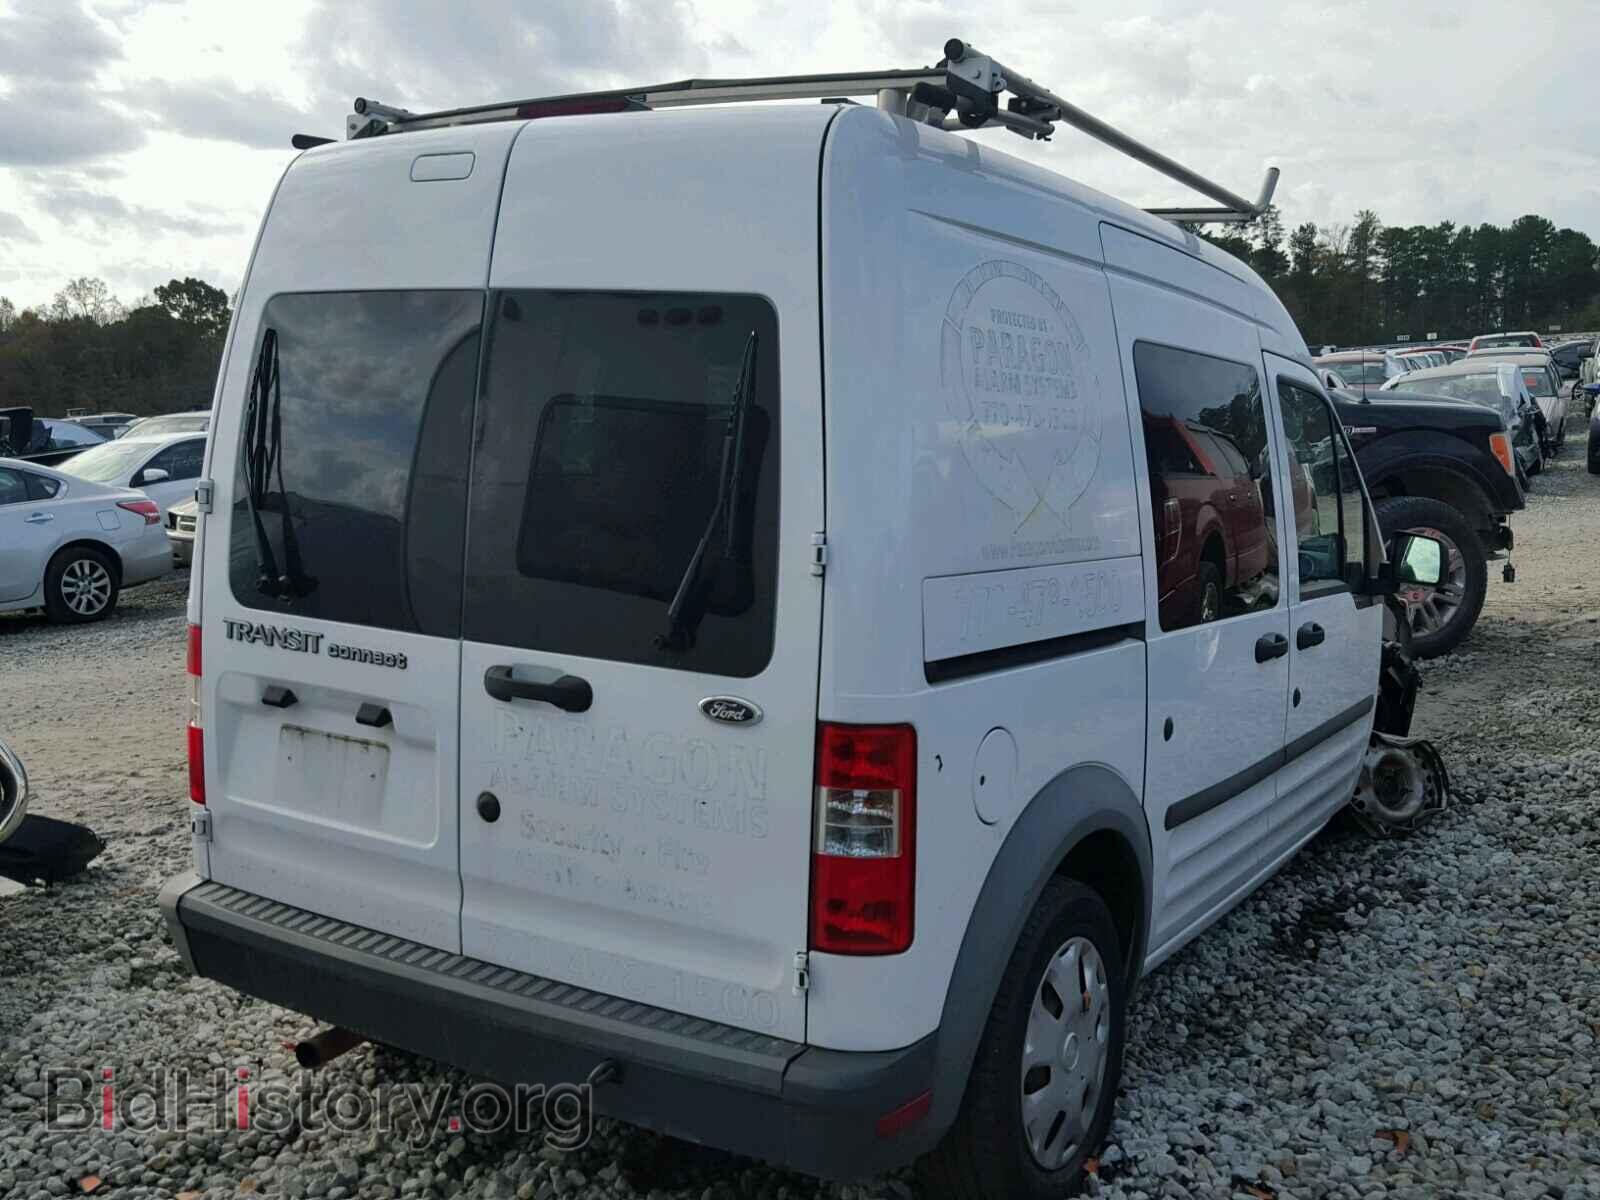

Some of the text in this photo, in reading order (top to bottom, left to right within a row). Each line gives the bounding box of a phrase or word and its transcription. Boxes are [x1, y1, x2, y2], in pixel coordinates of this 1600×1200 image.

[969, 326, 1073, 377] PARAGON
[223, 618, 408, 670] TRANSIT connect
[710, 703, 746, 722] Ford
[489, 706, 769, 802] PARAGON
[611, 784, 769, 840] SYSTEMS
